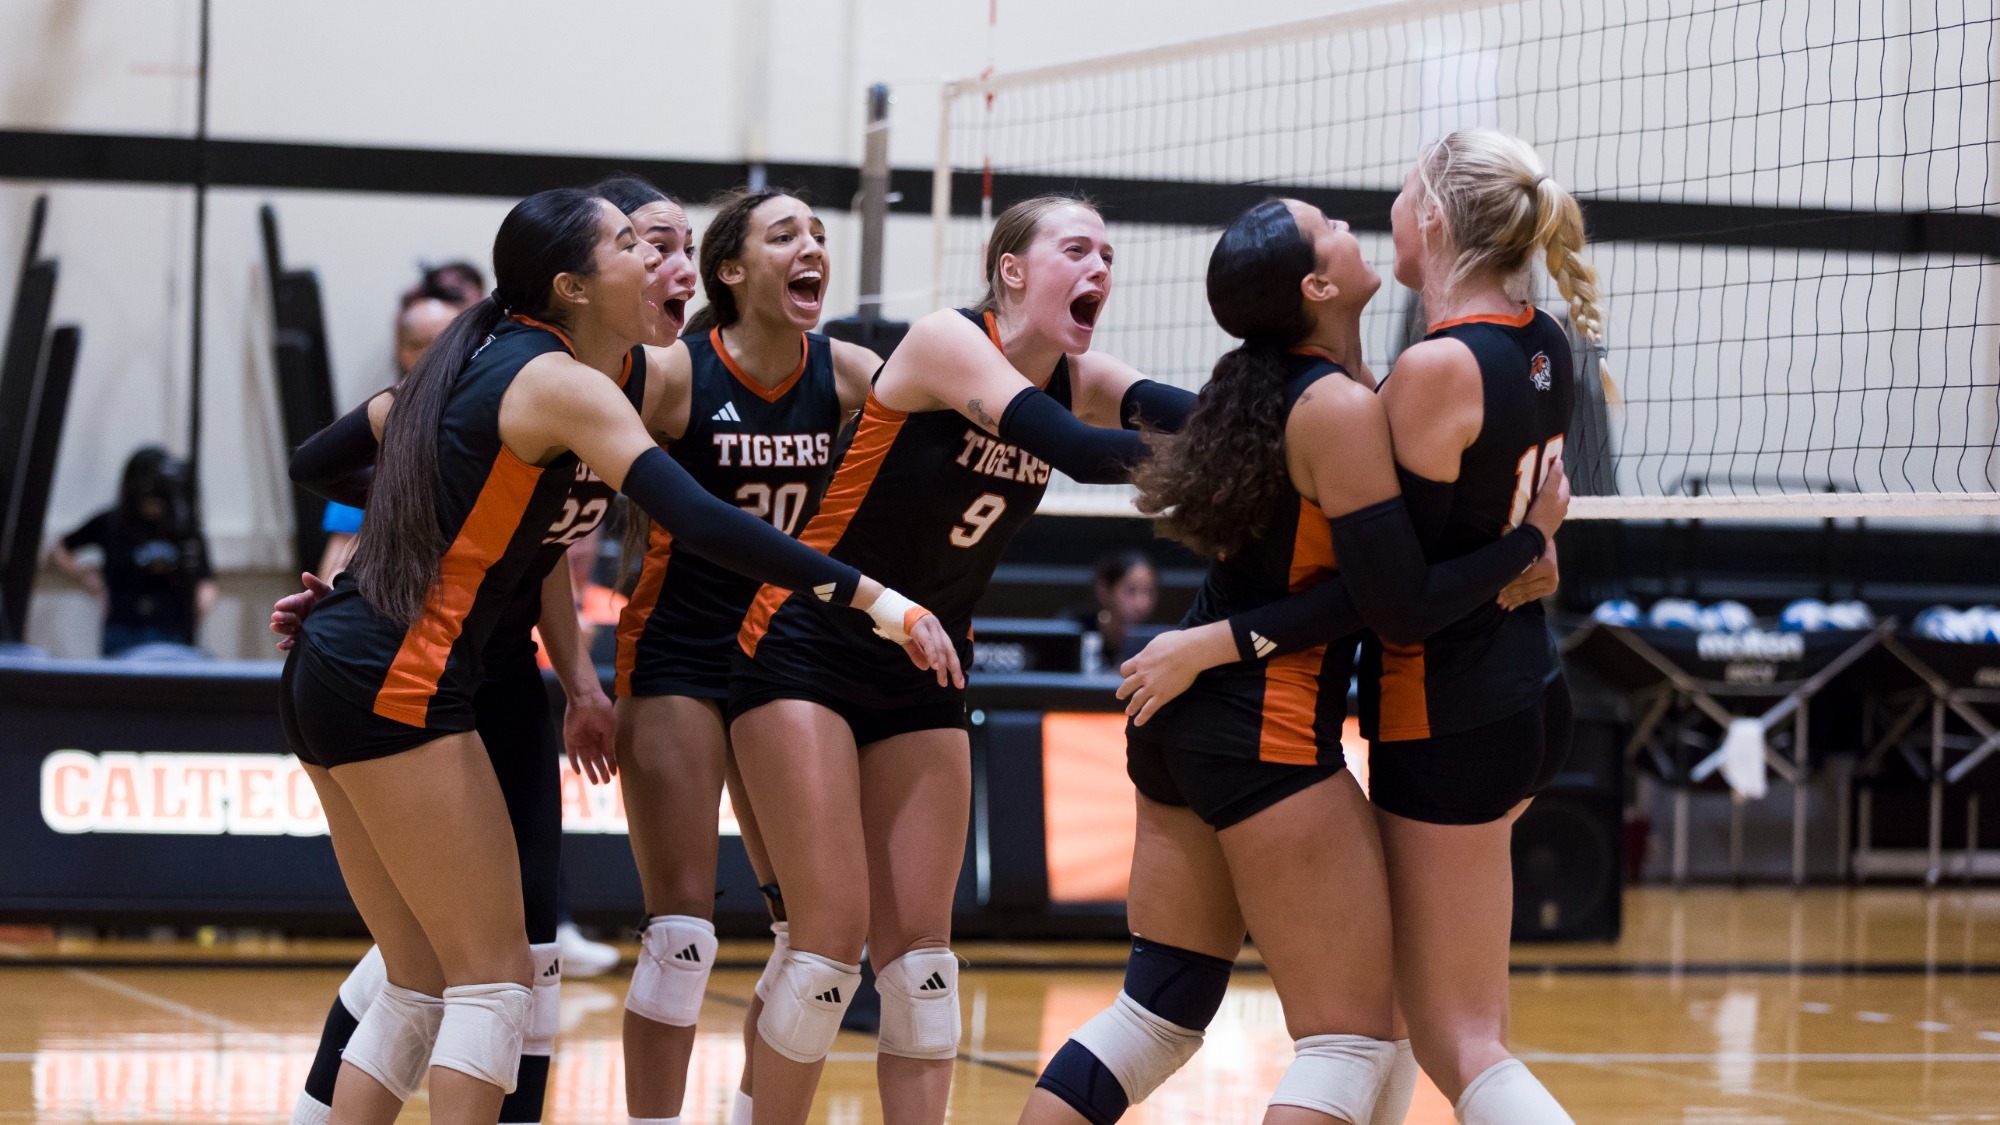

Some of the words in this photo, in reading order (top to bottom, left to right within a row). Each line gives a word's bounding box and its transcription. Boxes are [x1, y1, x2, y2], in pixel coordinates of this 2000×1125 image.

[713, 432, 831, 467] TIGERS
[955, 429, 1050, 486] TIGERS
[735, 482, 808, 537] 20
[948, 491, 1007, 549] 9
[50, 760, 324, 824] CALTEC
